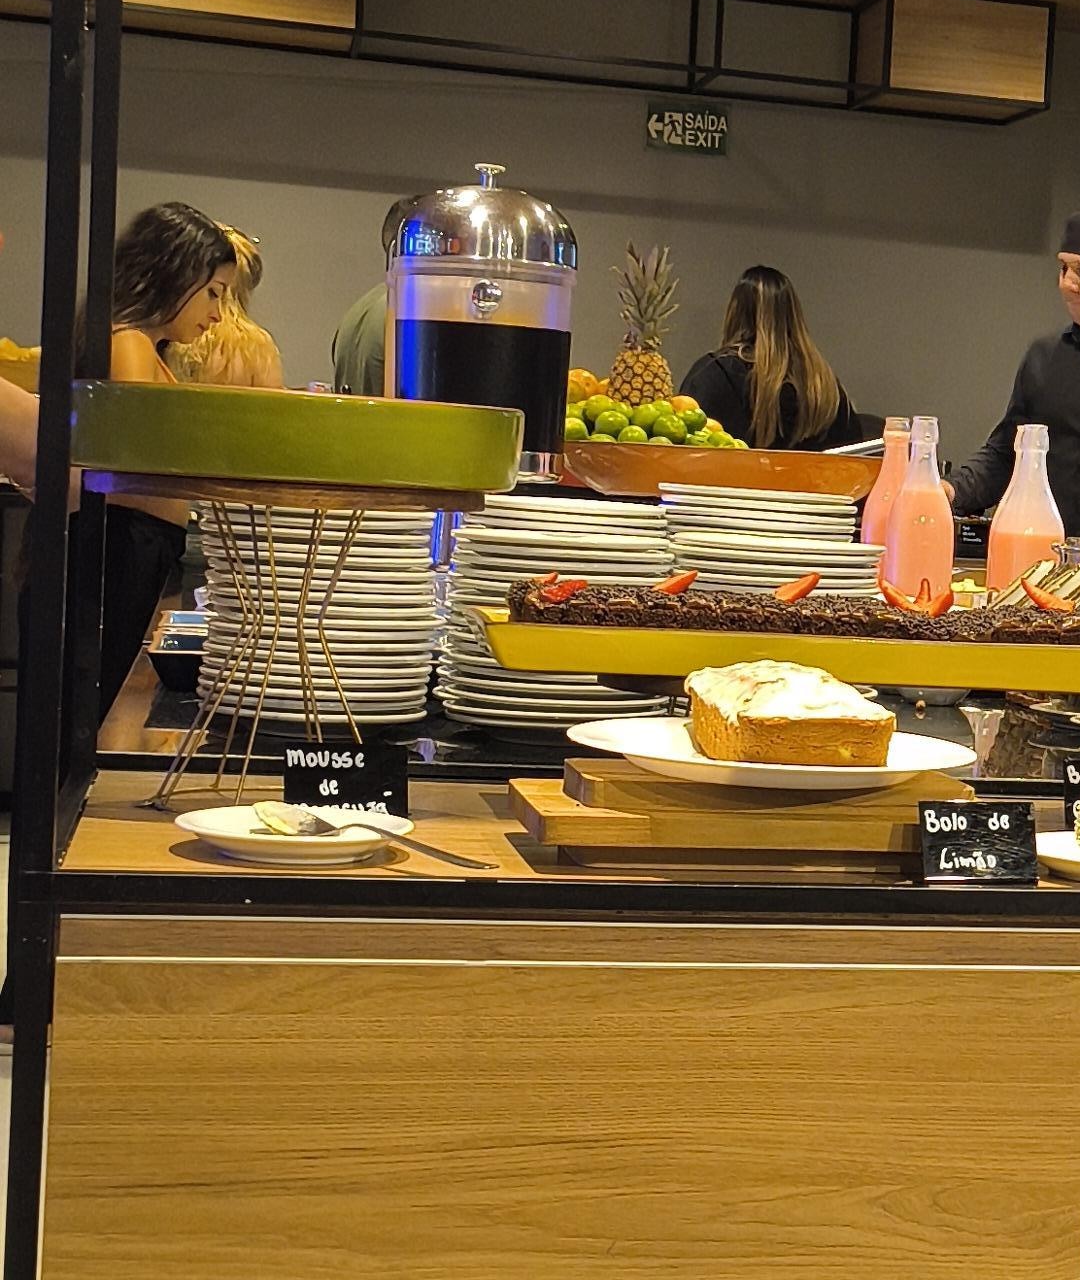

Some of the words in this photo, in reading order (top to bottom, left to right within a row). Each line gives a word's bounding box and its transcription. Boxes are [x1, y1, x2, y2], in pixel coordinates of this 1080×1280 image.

[685, 110, 728, 132] SAÍDA
[685, 130, 723, 148] EXIT
[319, 778, 339, 796] de
[924, 809, 968, 833] Bolo
[988, 812, 1010, 831] de
[940, 847, 997, 870] Limão
